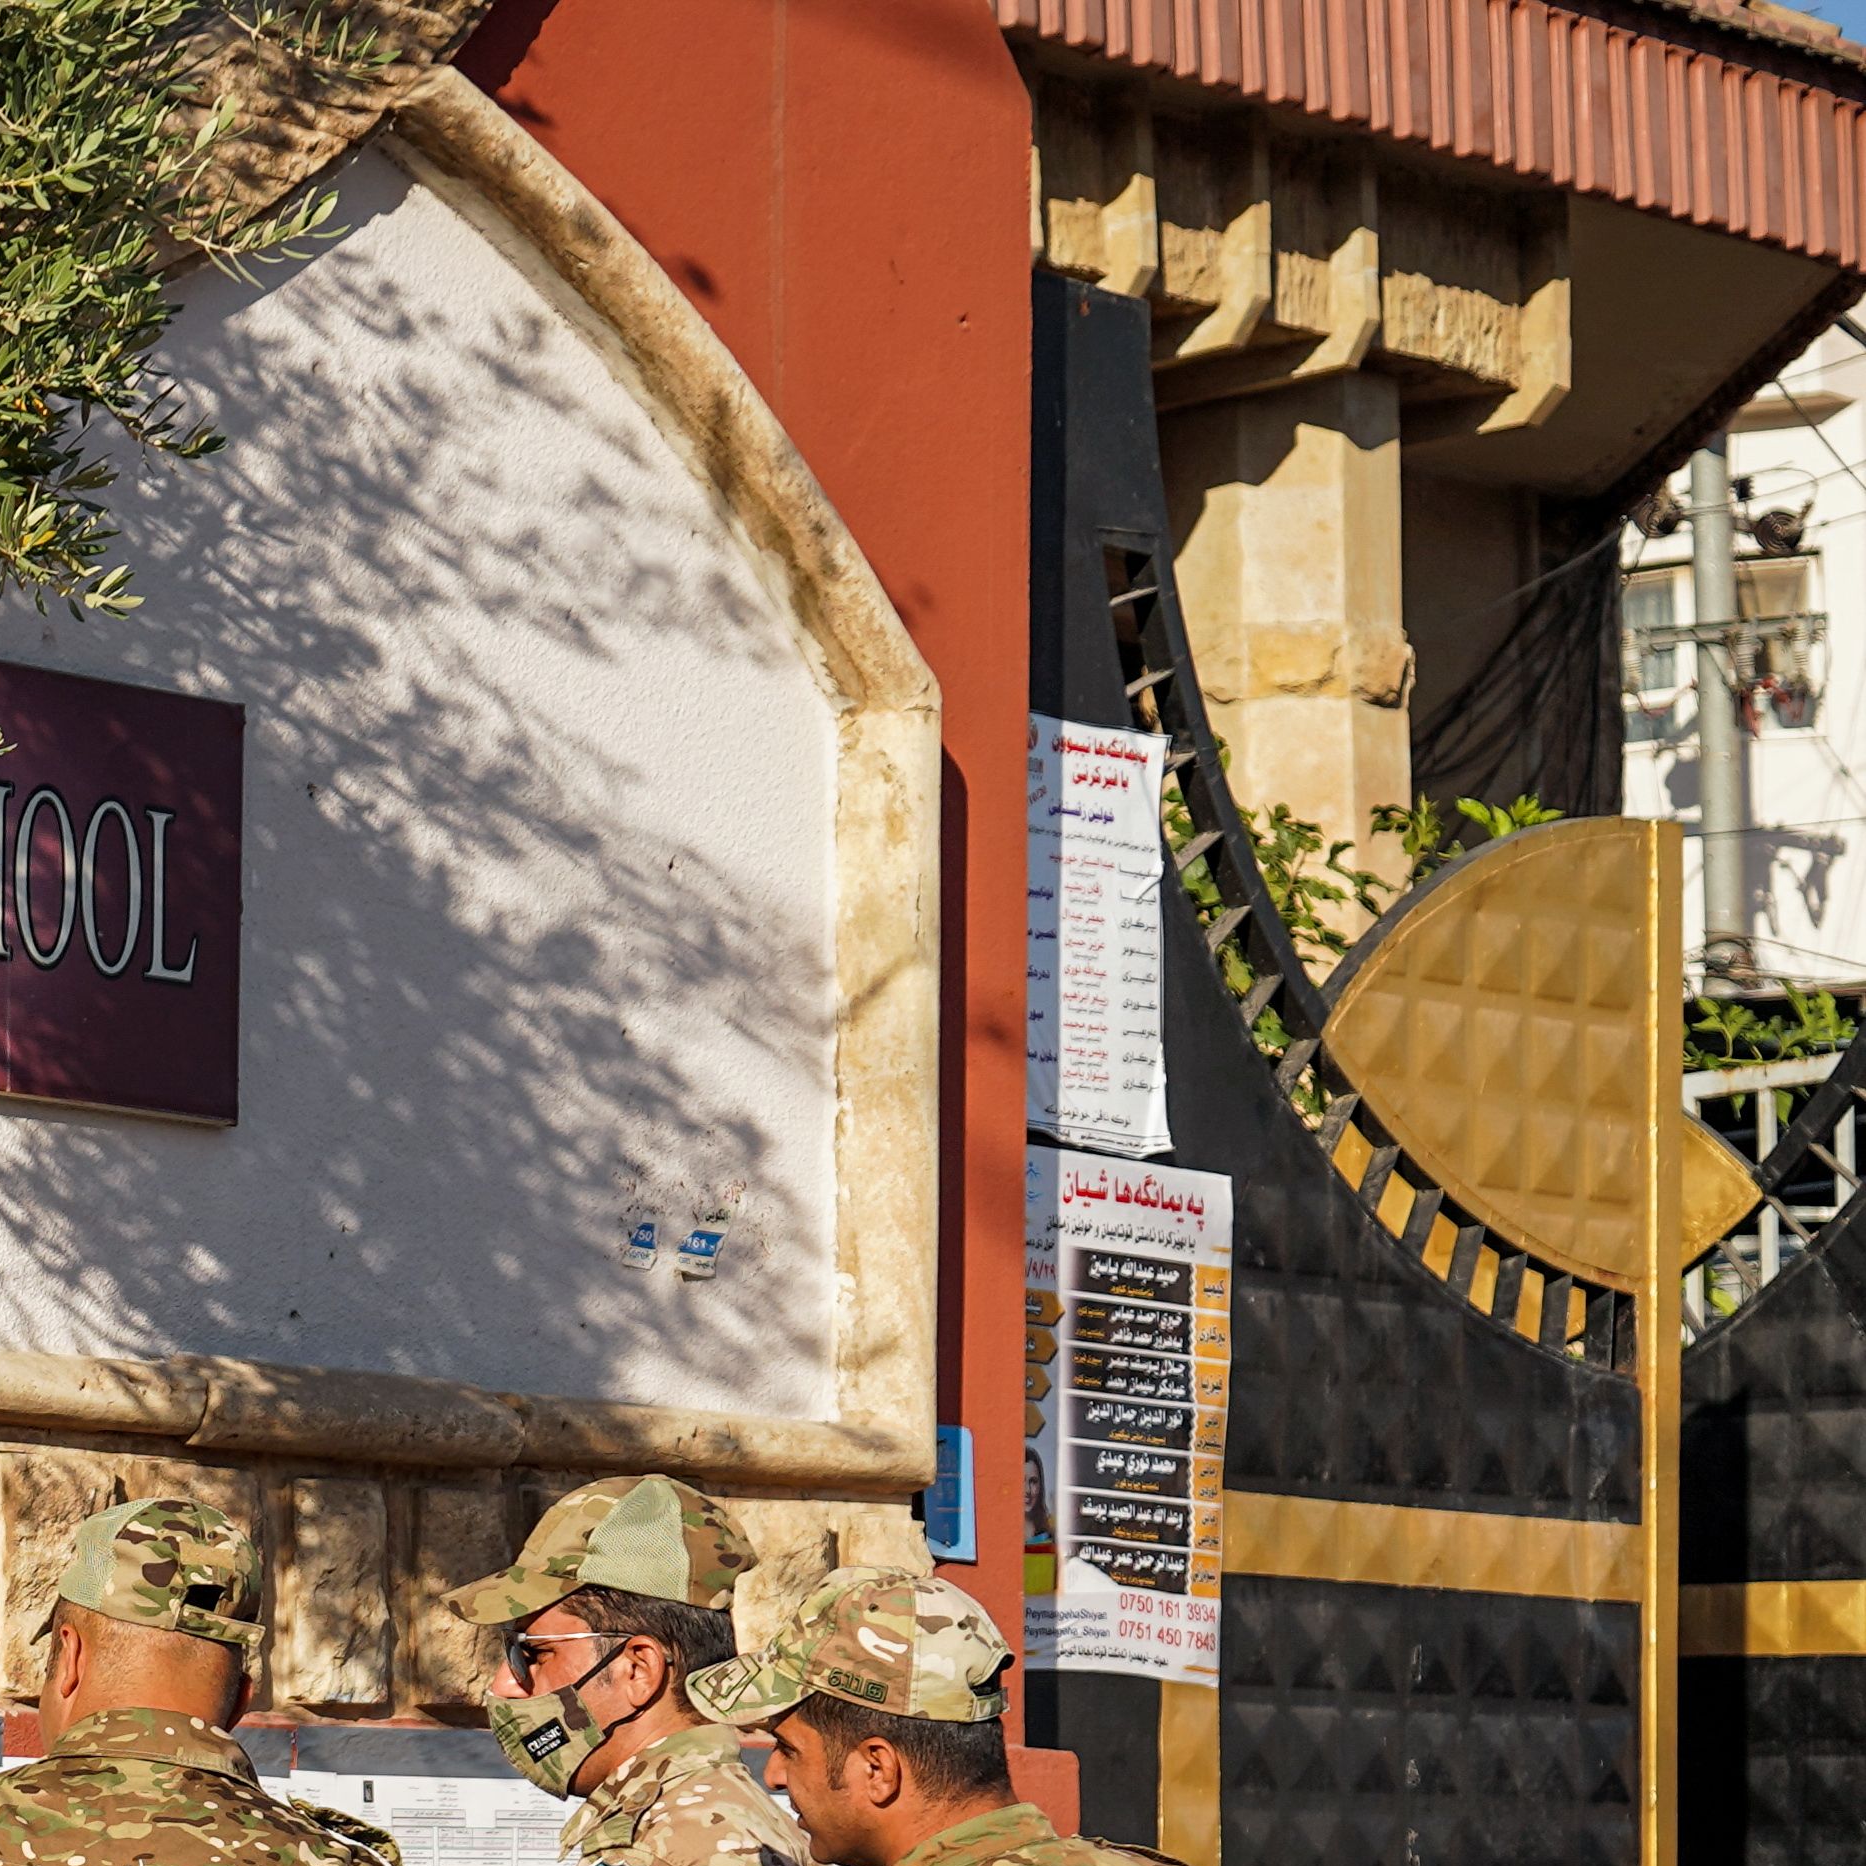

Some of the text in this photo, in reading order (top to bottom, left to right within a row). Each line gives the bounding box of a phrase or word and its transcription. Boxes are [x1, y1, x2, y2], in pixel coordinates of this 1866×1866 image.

[1120, 1592, 1216, 1624] 0750 161 3934
[1119, 1620, 1152, 1640] 0751
[1157, 1625, 1182, 1646] 450
